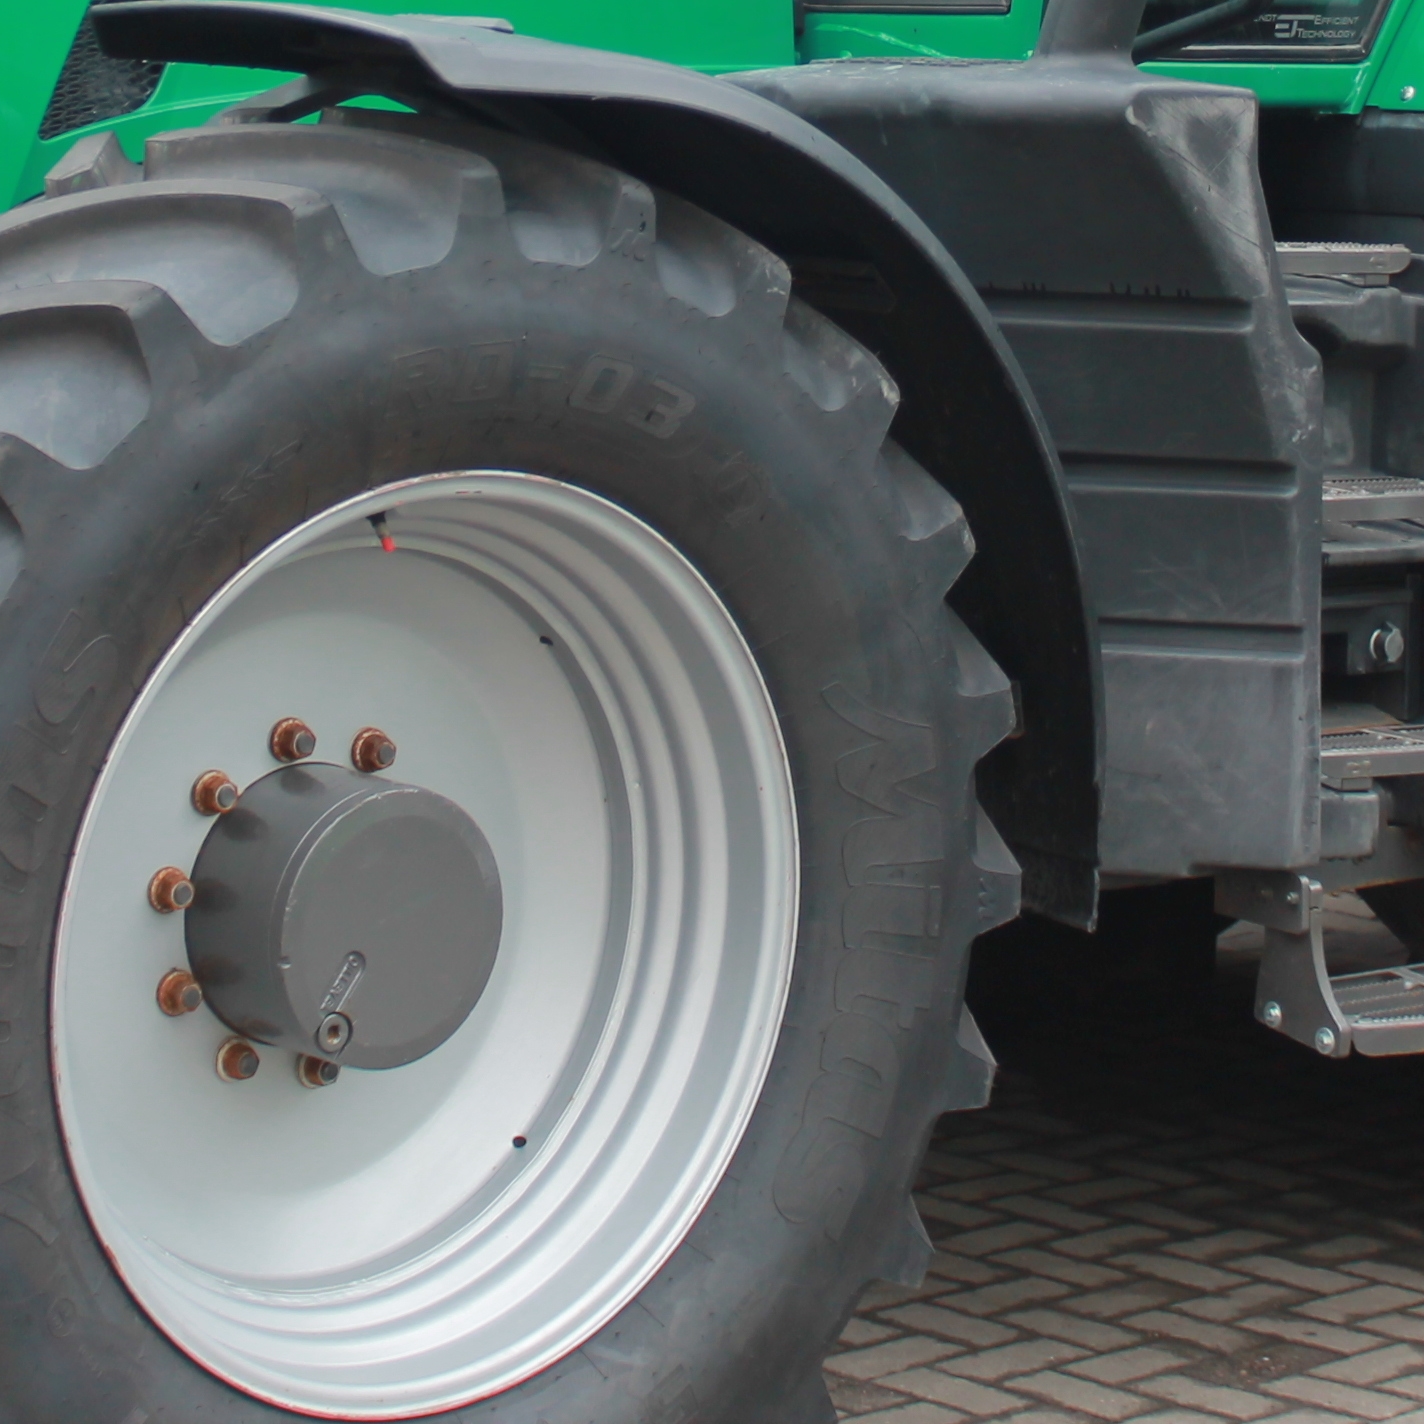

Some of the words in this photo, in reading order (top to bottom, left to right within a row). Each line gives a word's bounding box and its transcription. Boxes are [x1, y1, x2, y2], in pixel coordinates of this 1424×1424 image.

[1314, 14, 1360, 26] EFFICIENT
[1296, 27, 1357, 39] TECHNOLOGY
[774, 680, 946, 1248] Mitas
